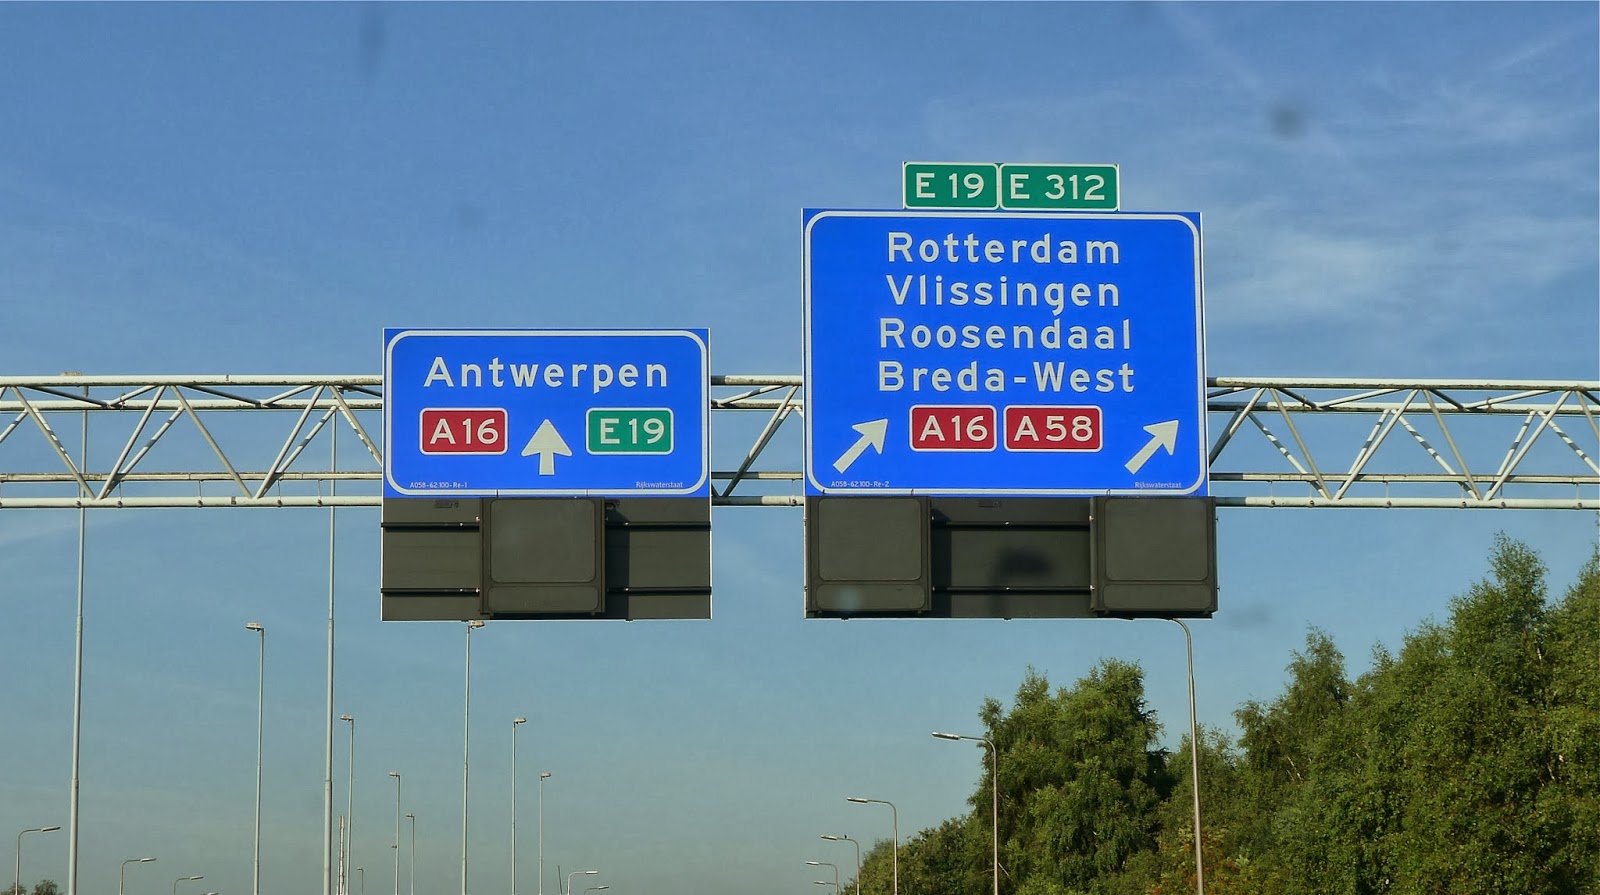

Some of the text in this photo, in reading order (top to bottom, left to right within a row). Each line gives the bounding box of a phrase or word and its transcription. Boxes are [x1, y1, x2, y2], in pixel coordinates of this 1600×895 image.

[916, 172, 985, 200] E 19
[1010, 173, 1106, 201] E 312
[888, 231, 1120, 265] Rotterdam
[886, 274, 1120, 316] Vlissingen
[879, 317, 1131, 350] Roosendaal
[423, 356, 668, 394] Antwerpen
[878, 360, 1135, 393] Breda-West
[635, 481, 683, 489] Rijkswaterstaat
[1134, 481, 1182, 490] Rijkswaterstaat
